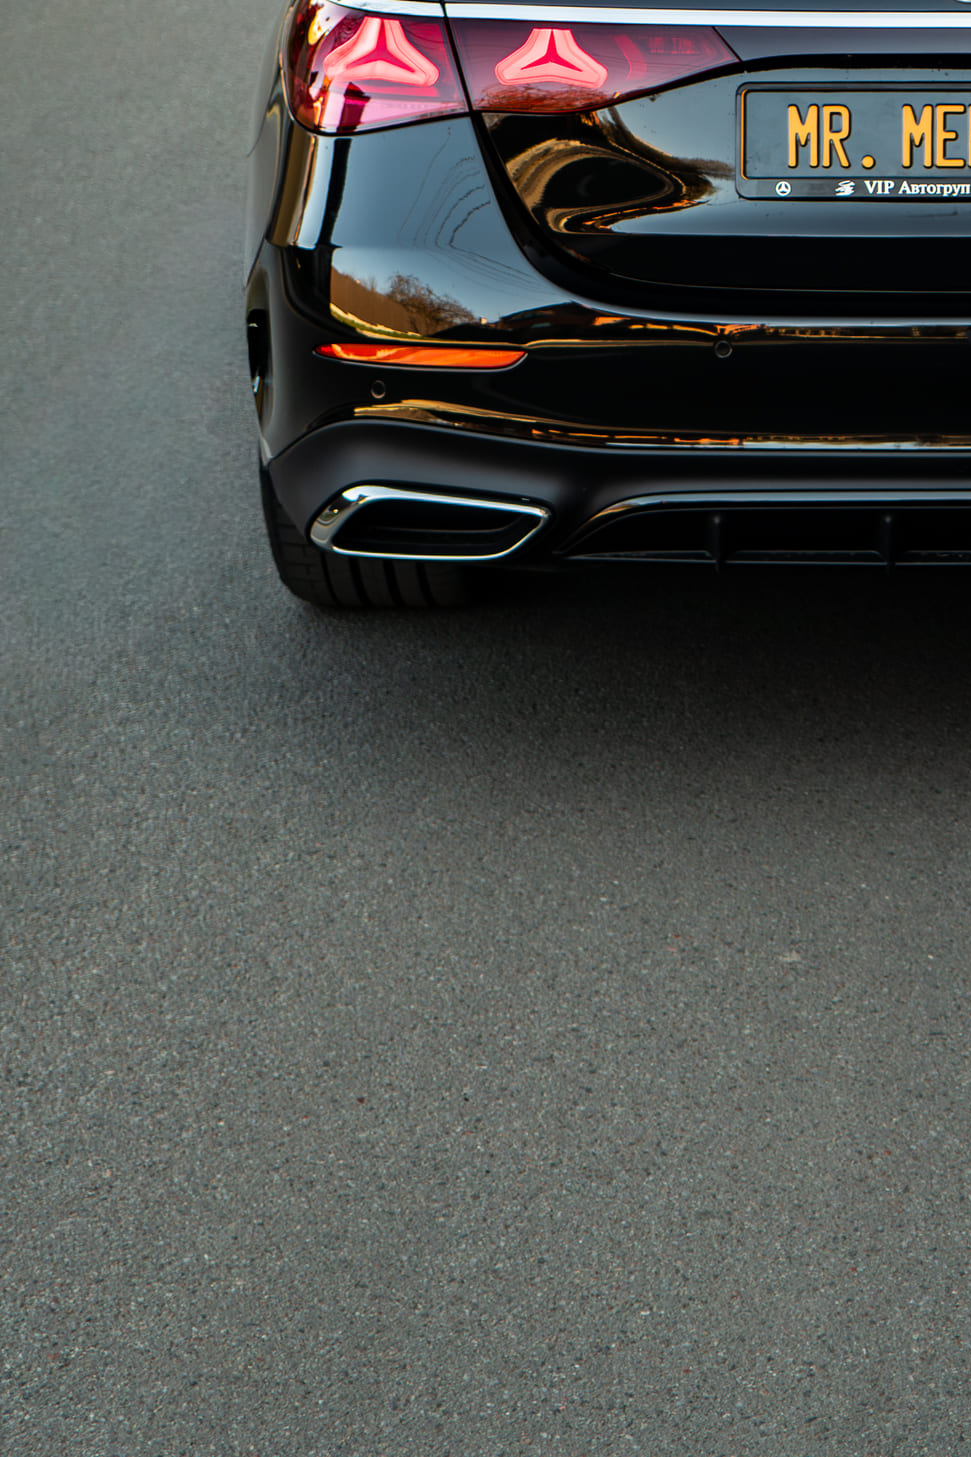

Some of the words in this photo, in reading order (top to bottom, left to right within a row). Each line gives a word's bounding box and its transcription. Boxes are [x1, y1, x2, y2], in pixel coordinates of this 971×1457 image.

[787, 104, 875, 168] MR.
[863, 180, 895, 195] VIP
[898, 180, 971, 197] Автогруп
